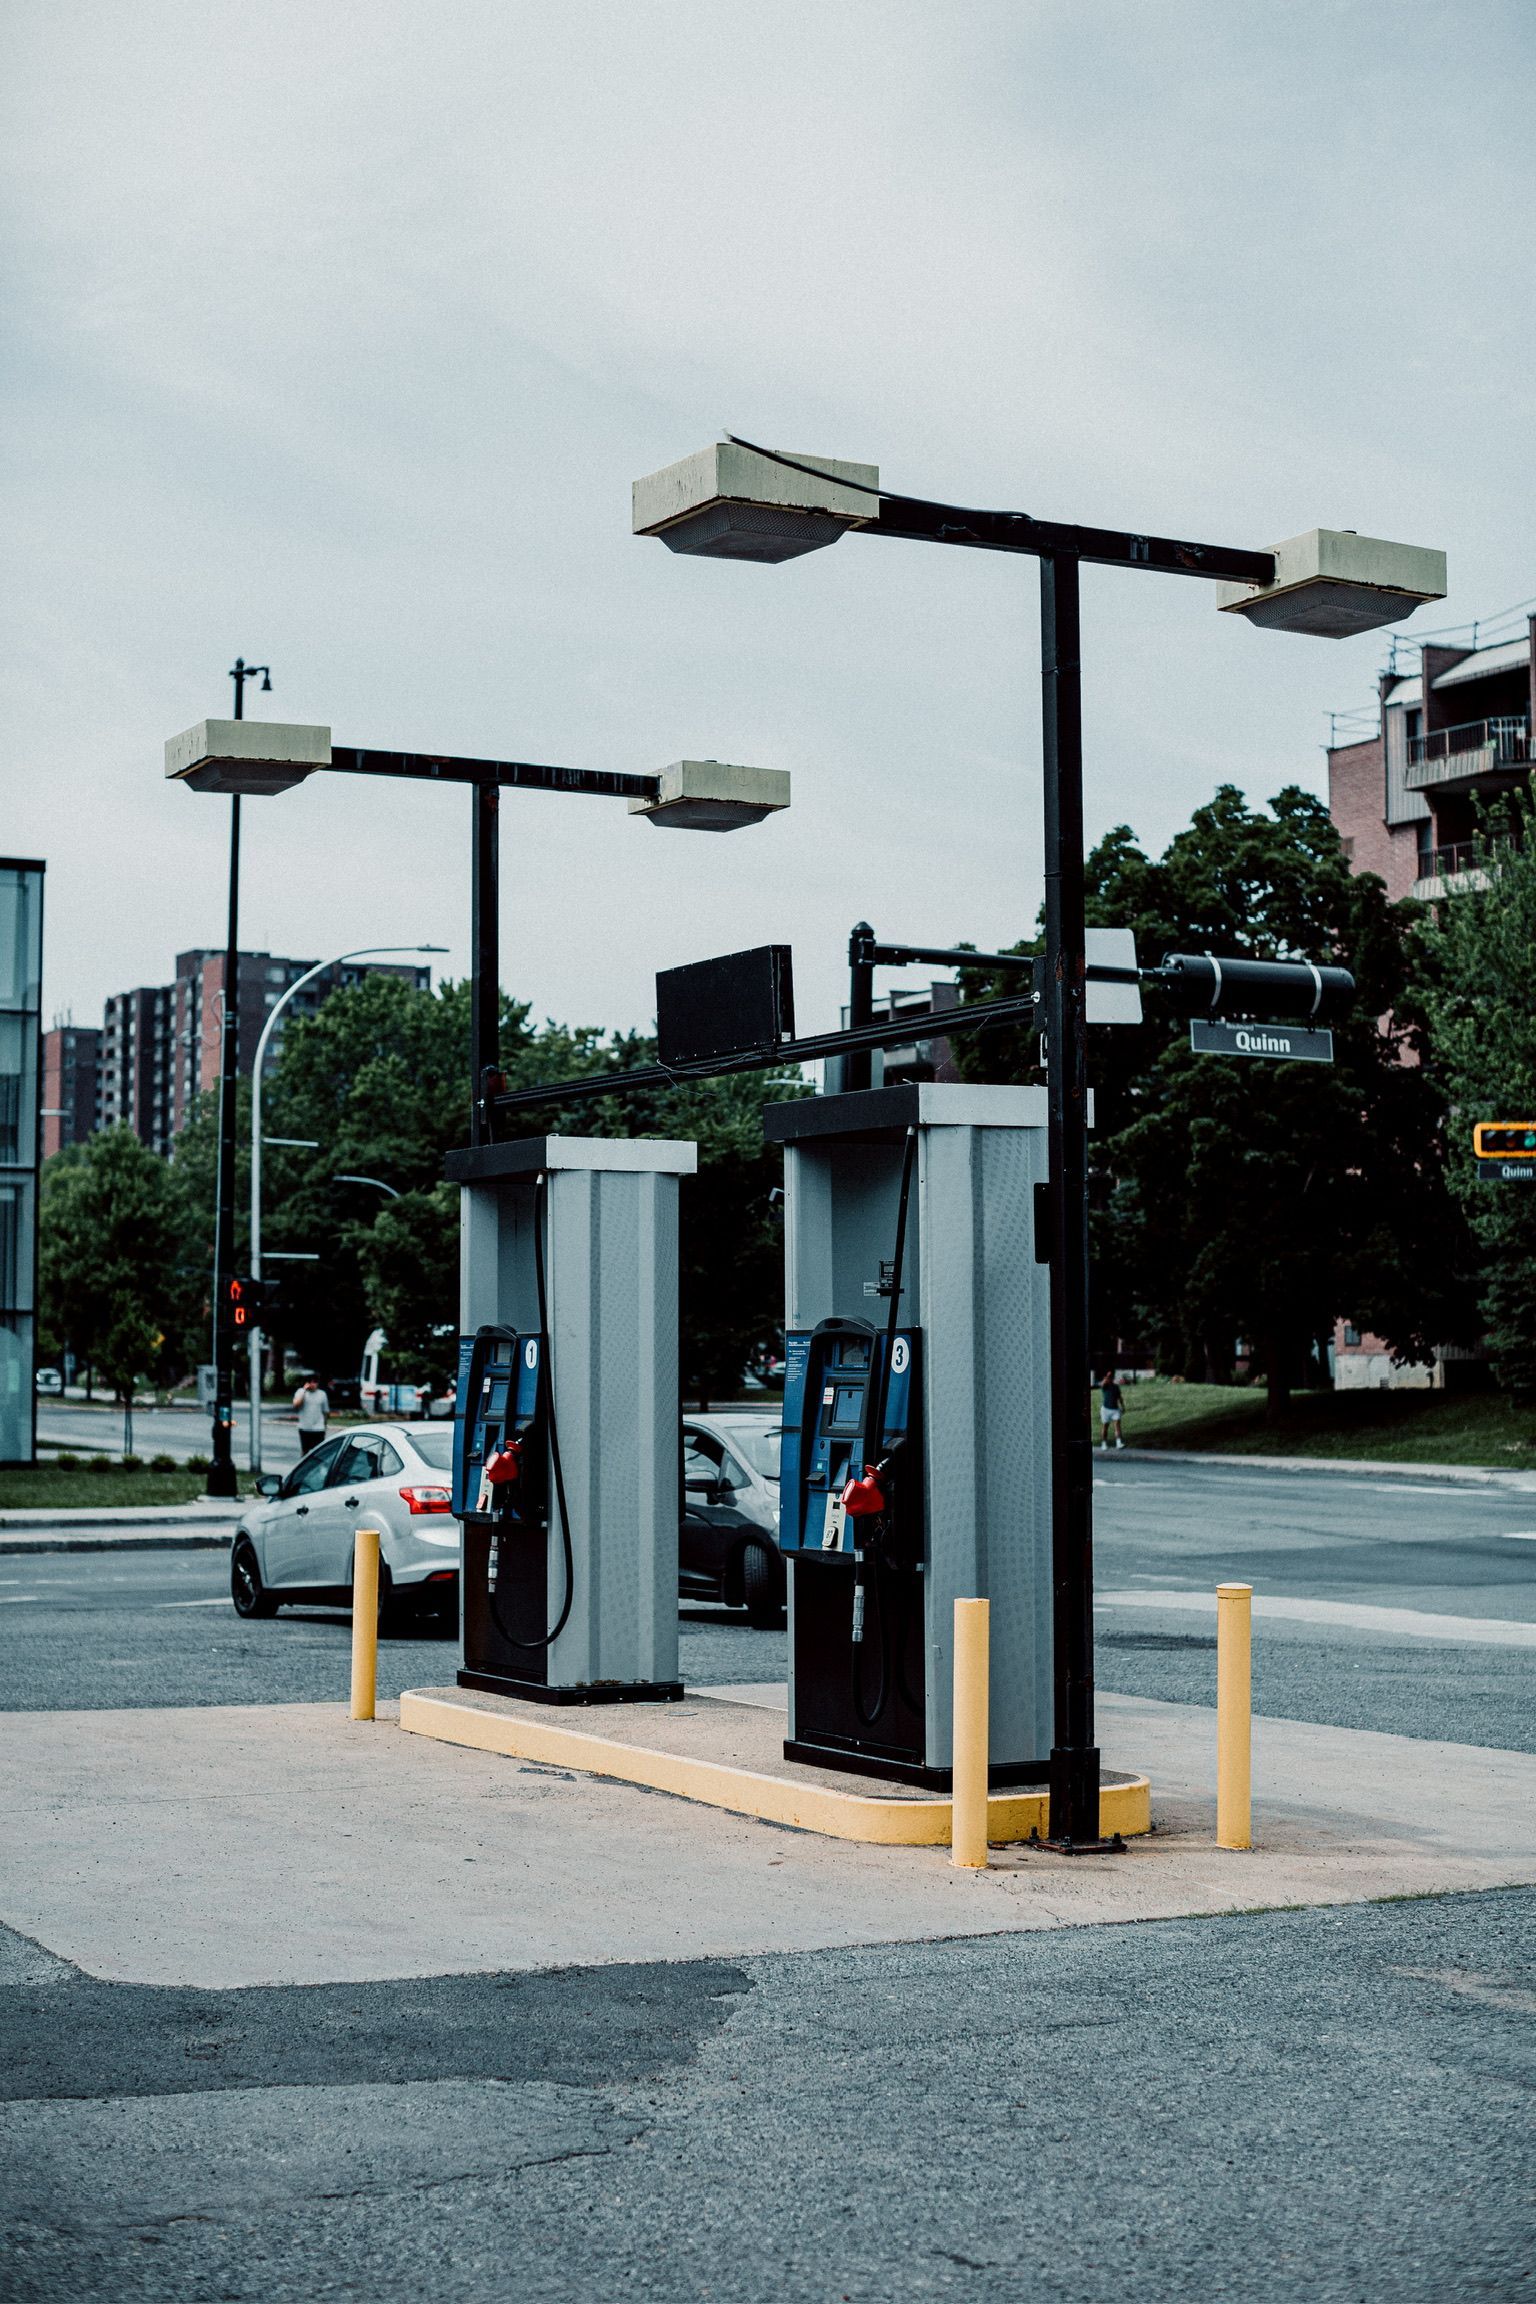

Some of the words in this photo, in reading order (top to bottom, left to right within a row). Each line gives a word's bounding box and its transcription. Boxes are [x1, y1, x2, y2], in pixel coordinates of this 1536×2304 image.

[1235, 1031, 1291, 1053] Quinn
[1502, 1165, 1533, 1179] Quinn
[529, 1346, 534, 1363] 1
[895, 1345, 904, 1366] 3
